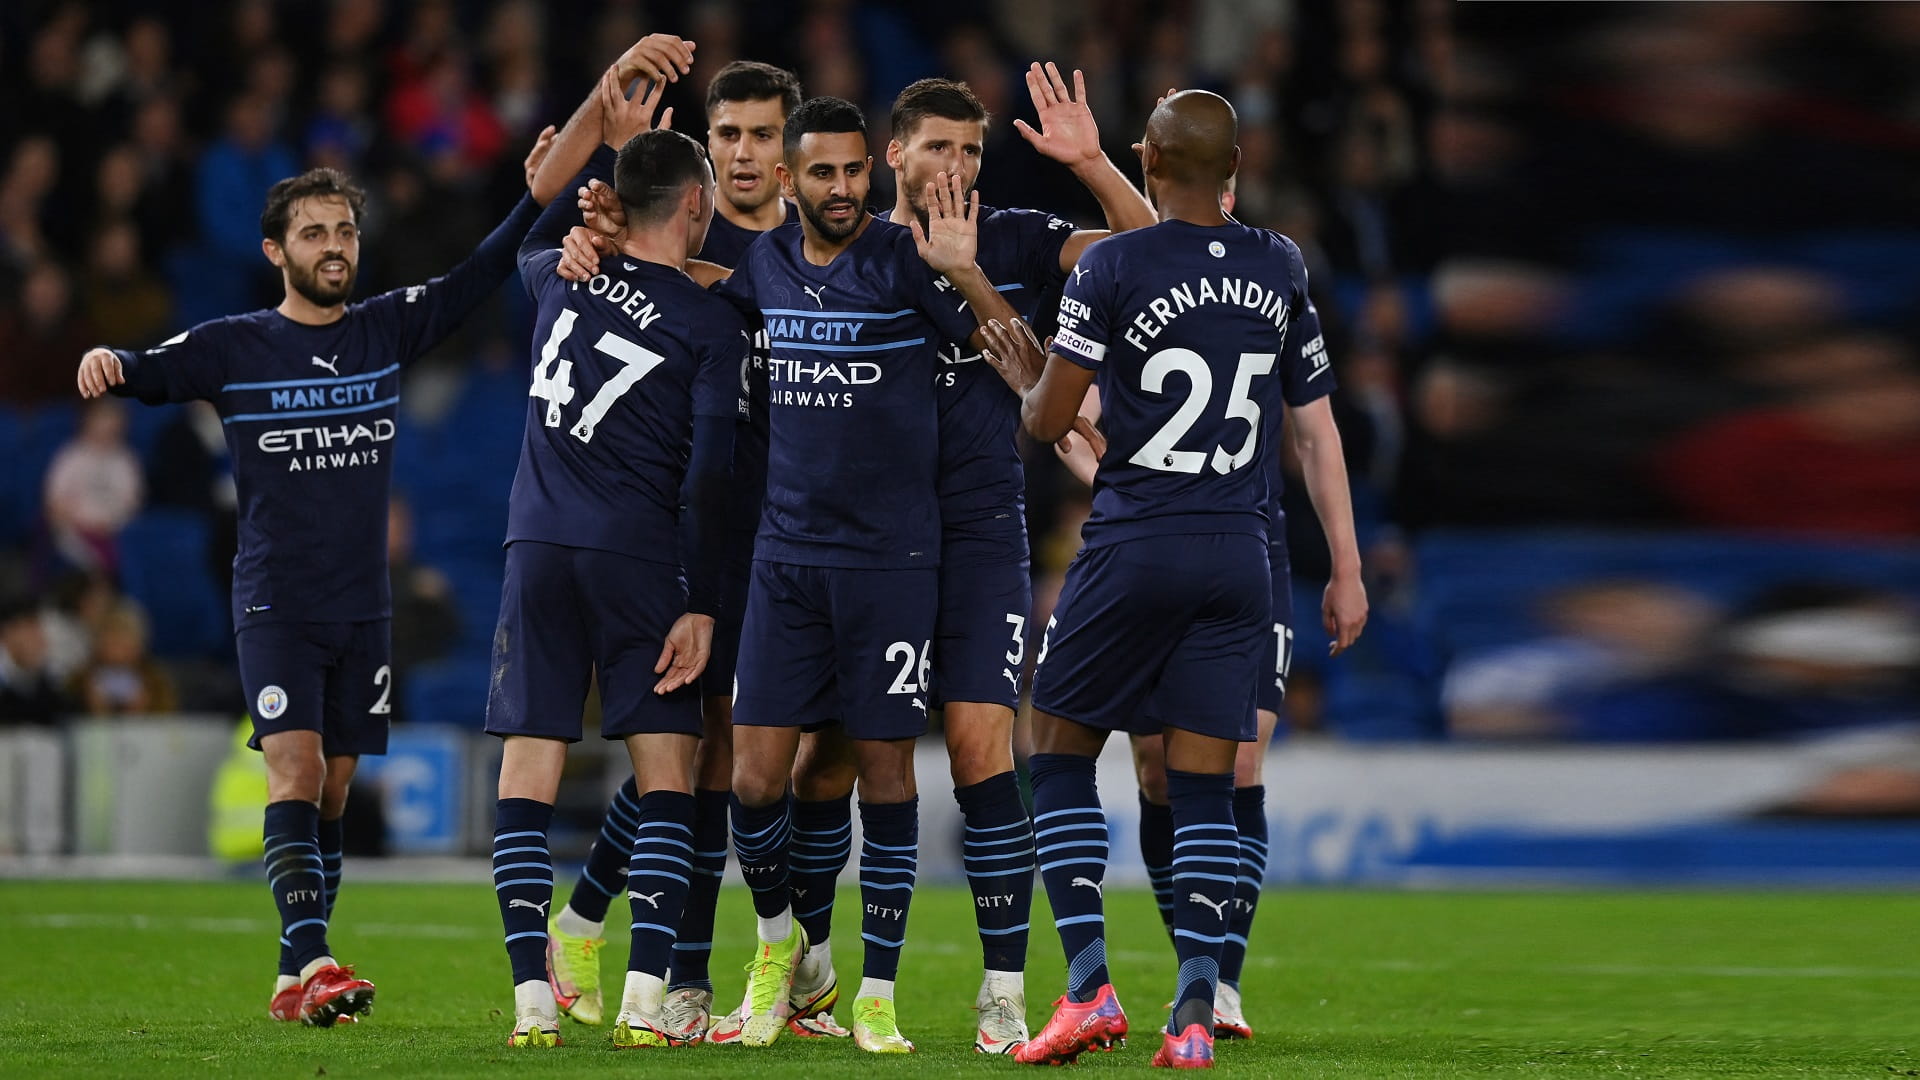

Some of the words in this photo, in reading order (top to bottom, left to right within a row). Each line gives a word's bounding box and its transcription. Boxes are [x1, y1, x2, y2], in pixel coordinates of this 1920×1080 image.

[1059, 295, 1091, 321] EXEN
[1124, 277, 1290, 354] FERNANDIN
[810, 321, 864, 342] CITY
[1057, 332, 1093, 354] ptain
[529, 307, 666, 443] 47
[271, 389, 326, 410] MAN
[330, 381, 377, 405] CITY
[771, 389, 854, 408] AIRWAYS
[1128, 347, 1277, 476] 25
[258, 418, 396, 453] ETIHAD
[289, 449, 379, 472] AIRWAYS
[1005, 612, 1025, 666] 3
[885, 639, 931, 695] 26
[369, 664, 392, 715] 2
[741, 863, 778, 875] CITY
[286, 889, 319, 905] CITY
[976, 893, 1015, 910] CITY
[1232, 897, 1254, 914] TY
[866, 903, 903, 921] CITY
